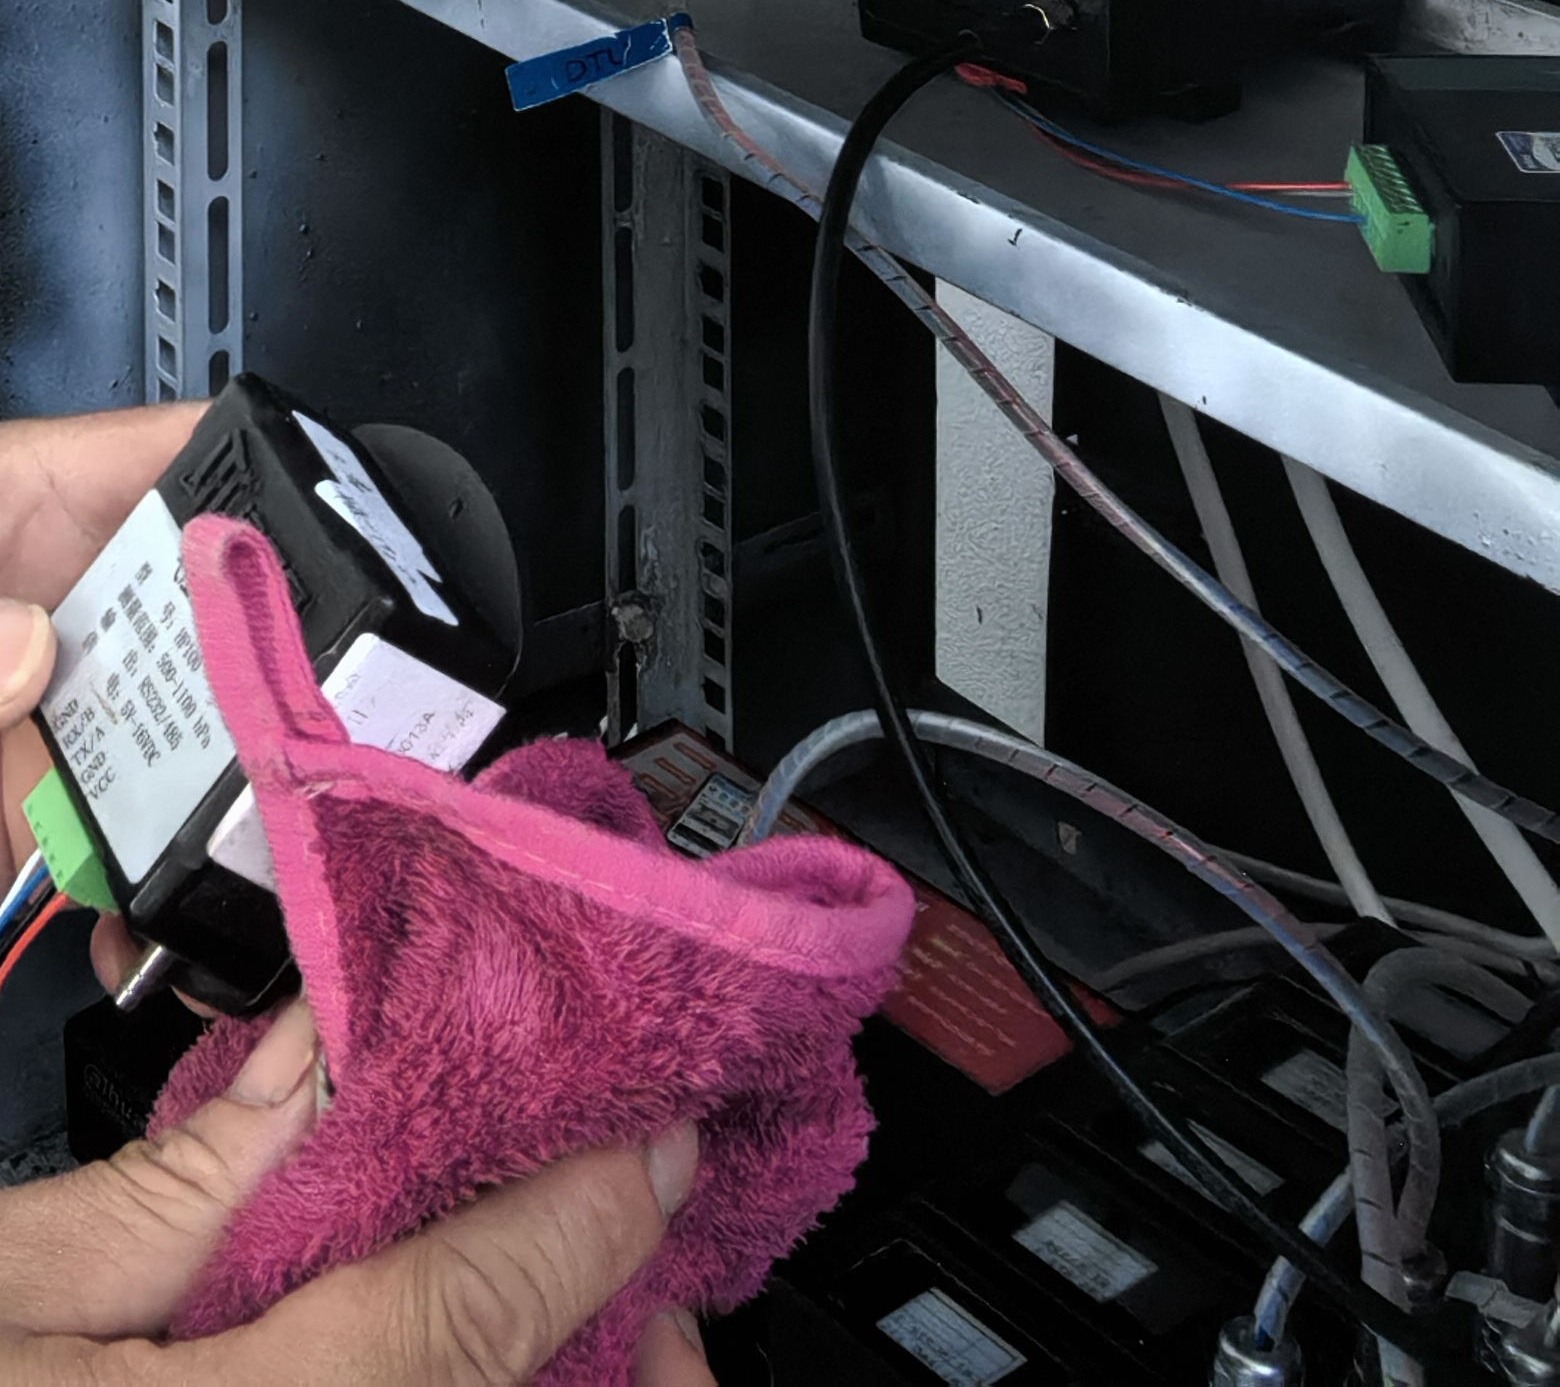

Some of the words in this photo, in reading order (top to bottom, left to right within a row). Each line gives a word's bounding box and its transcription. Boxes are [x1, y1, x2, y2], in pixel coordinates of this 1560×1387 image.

[71, 727, 105, 767] TX/A
[80, 751, 107, 784] GND
[87, 768, 116, 800] VCC
